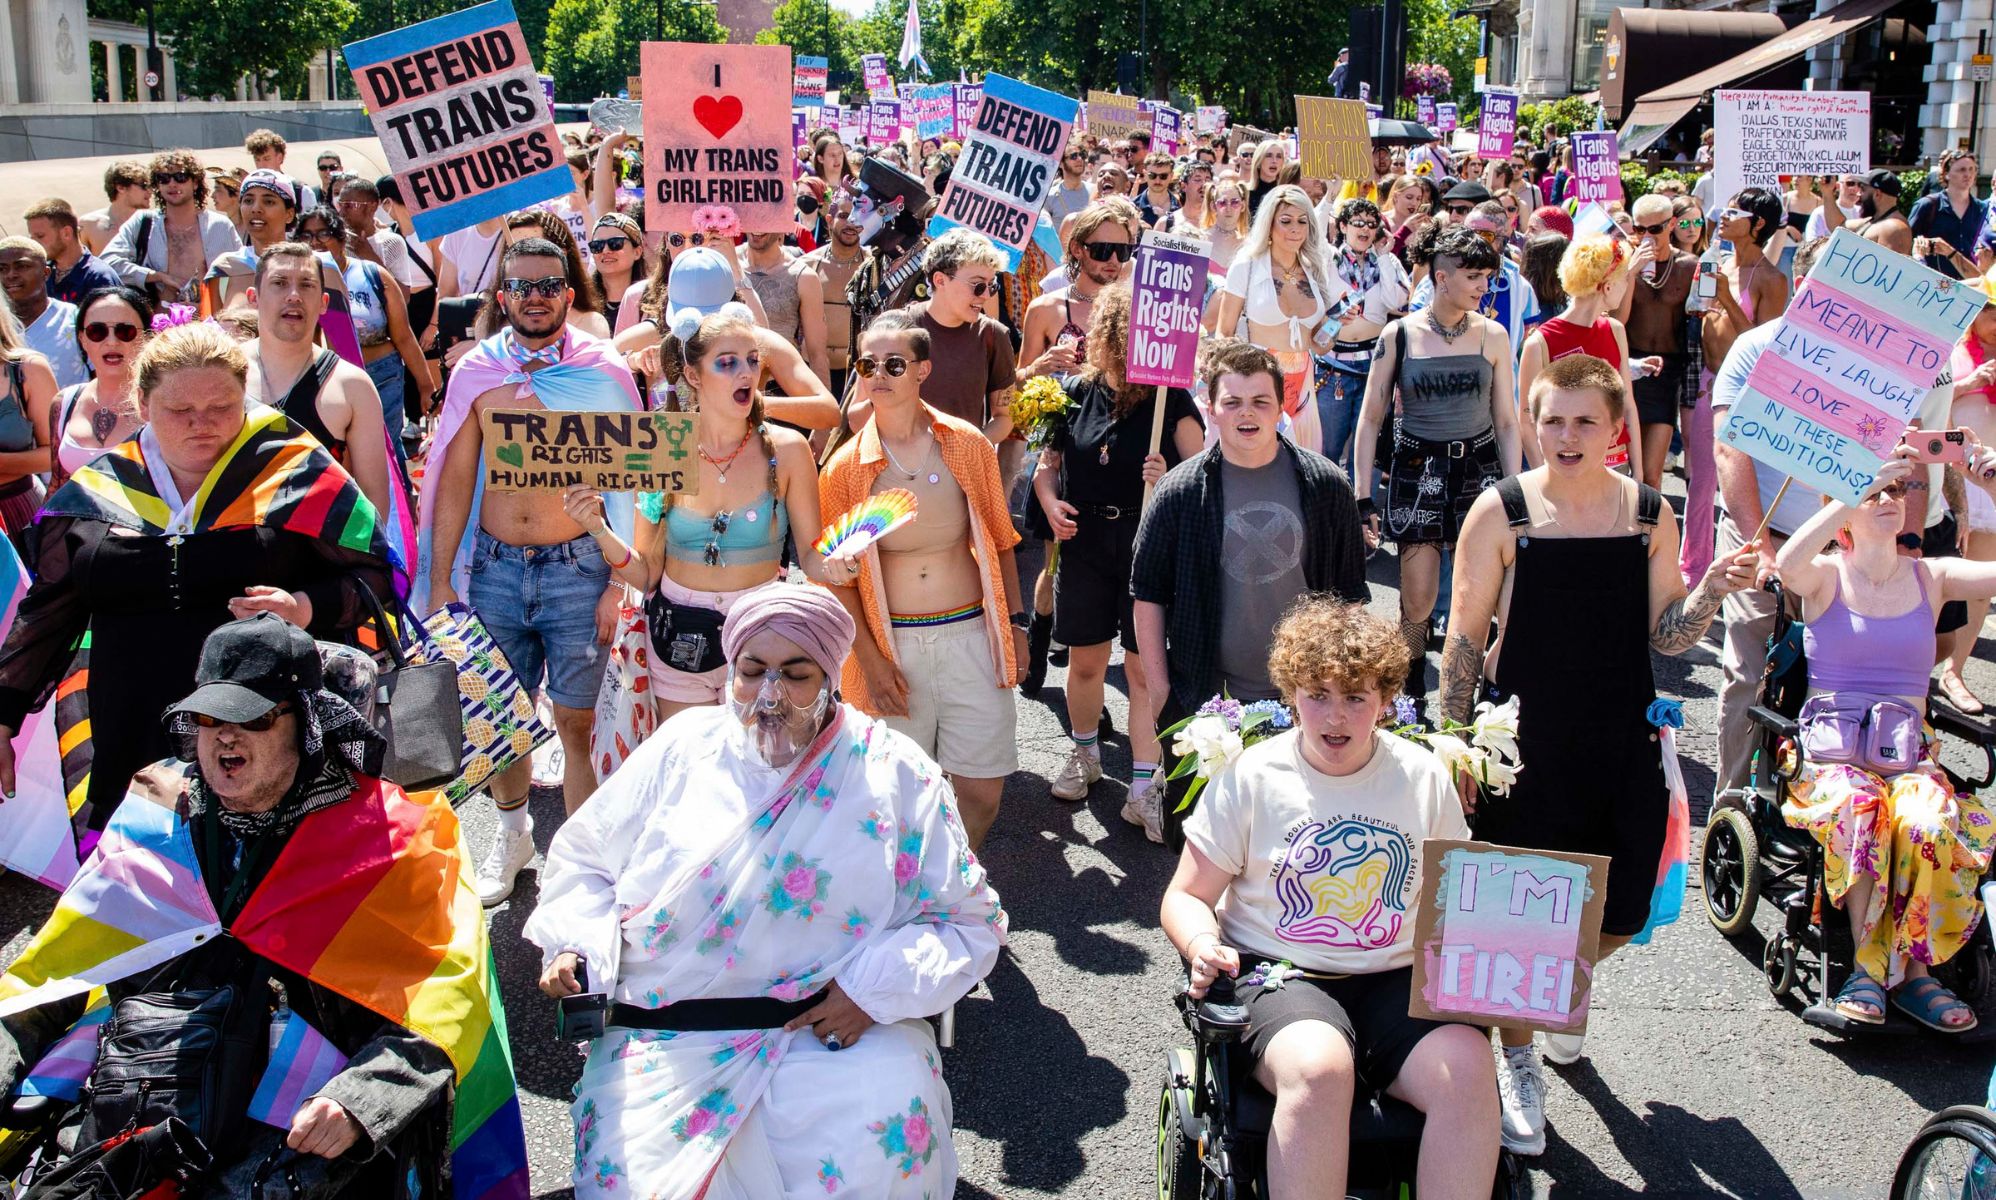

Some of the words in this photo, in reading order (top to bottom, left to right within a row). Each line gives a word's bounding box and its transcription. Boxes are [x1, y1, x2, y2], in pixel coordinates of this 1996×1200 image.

[145, 73, 158, 85] 20
[365, 29, 517, 108] DEFEND
[714, 64, 721, 88] I
[954, 85, 982, 101] Tran
[1484, 93, 1511, 113] Trans
[871, 102, 894, 114] Trans
[1155, 107, 1175, 127] Trans
[1299, 97, 1367, 138] TRANNY
[1737, 100, 1741, 111] I
[1746, 101, 1760, 110] AM
[387, 78, 538, 160] TRANS
[871, 113, 898, 127] Rights
[977, 97, 1062, 156] DEFEND
[1483, 112, 1514, 136] Rights
[1783, 116, 1812, 128] TEXAS
[1814, 118, 1847, 129] NATIVE
[870, 126, 888, 138] Now
[1154, 123, 1177, 143] Rights
[1481, 131, 1503, 151] Now
[1742, 127, 1802, 140] TRAFFICKING
[1803, 129, 1847, 141] SURVIVOR
[1573, 135, 1609, 155] Trans
[1742, 139, 1772, 150] EAGLE
[1776, 139, 1806, 151] SCOUT
[1742, 150, 1806, 162] GEORGETOWN
[1835, 151, 1861, 162] ALUM
[409, 131, 553, 210] FUTURES
[664, 148, 699, 173] MY
[706, 148, 779, 173] TRANS
[961, 140, 1047, 201] TRANS
[1301, 139, 1370, 180] GORGEOUS
[1577, 156, 1618, 182] Rights
[657, 179, 785, 204] GIRLFRIEND
[1578, 180, 1608, 200] Now
[1743, 174, 1777, 185] TRANS
[942, 187, 1030, 246] FUTURES
[1153, 236, 1181, 251] Socialist
[1180, 241, 1201, 255] Worker
[1141, 247, 1193, 292] Trans
[1825, 238, 1902, 295] HOW
[1904, 279, 1955, 317] AM
[1952, 303, 1981, 331] I
[1136, 288, 1199, 337] Rights
[1799, 289, 1900, 350] MEANT
[1905, 338, 1940, 370] TO
[1132, 329, 1177, 370] Now
[1774, 324, 1836, 374] LIVE,
[1841, 363, 1915, 416] LAUGH,
[1791, 379, 1850, 417] LOVE
[492, 412, 658, 450] TRANS
[1763, 400, 1784, 422] IN
[1793, 415, 1848, 457] THESE
[531, 445, 613, 465] RIGHTS
[1730, 415, 1874, 496] CONDITIONS?
[490, 470, 583, 488] HUMAN
[597, 471, 684, 490] RIGHTS
[1284, 816, 1314, 843] BODIES
[1327, 813, 1344, 828] ARE
[1351, 813, 1399, 832] BEAUTIFUL
[1403, 832, 1416, 850] AND
[1404, 858, 1418, 893] SACRED
[1459, 862, 1572, 924] I'M
